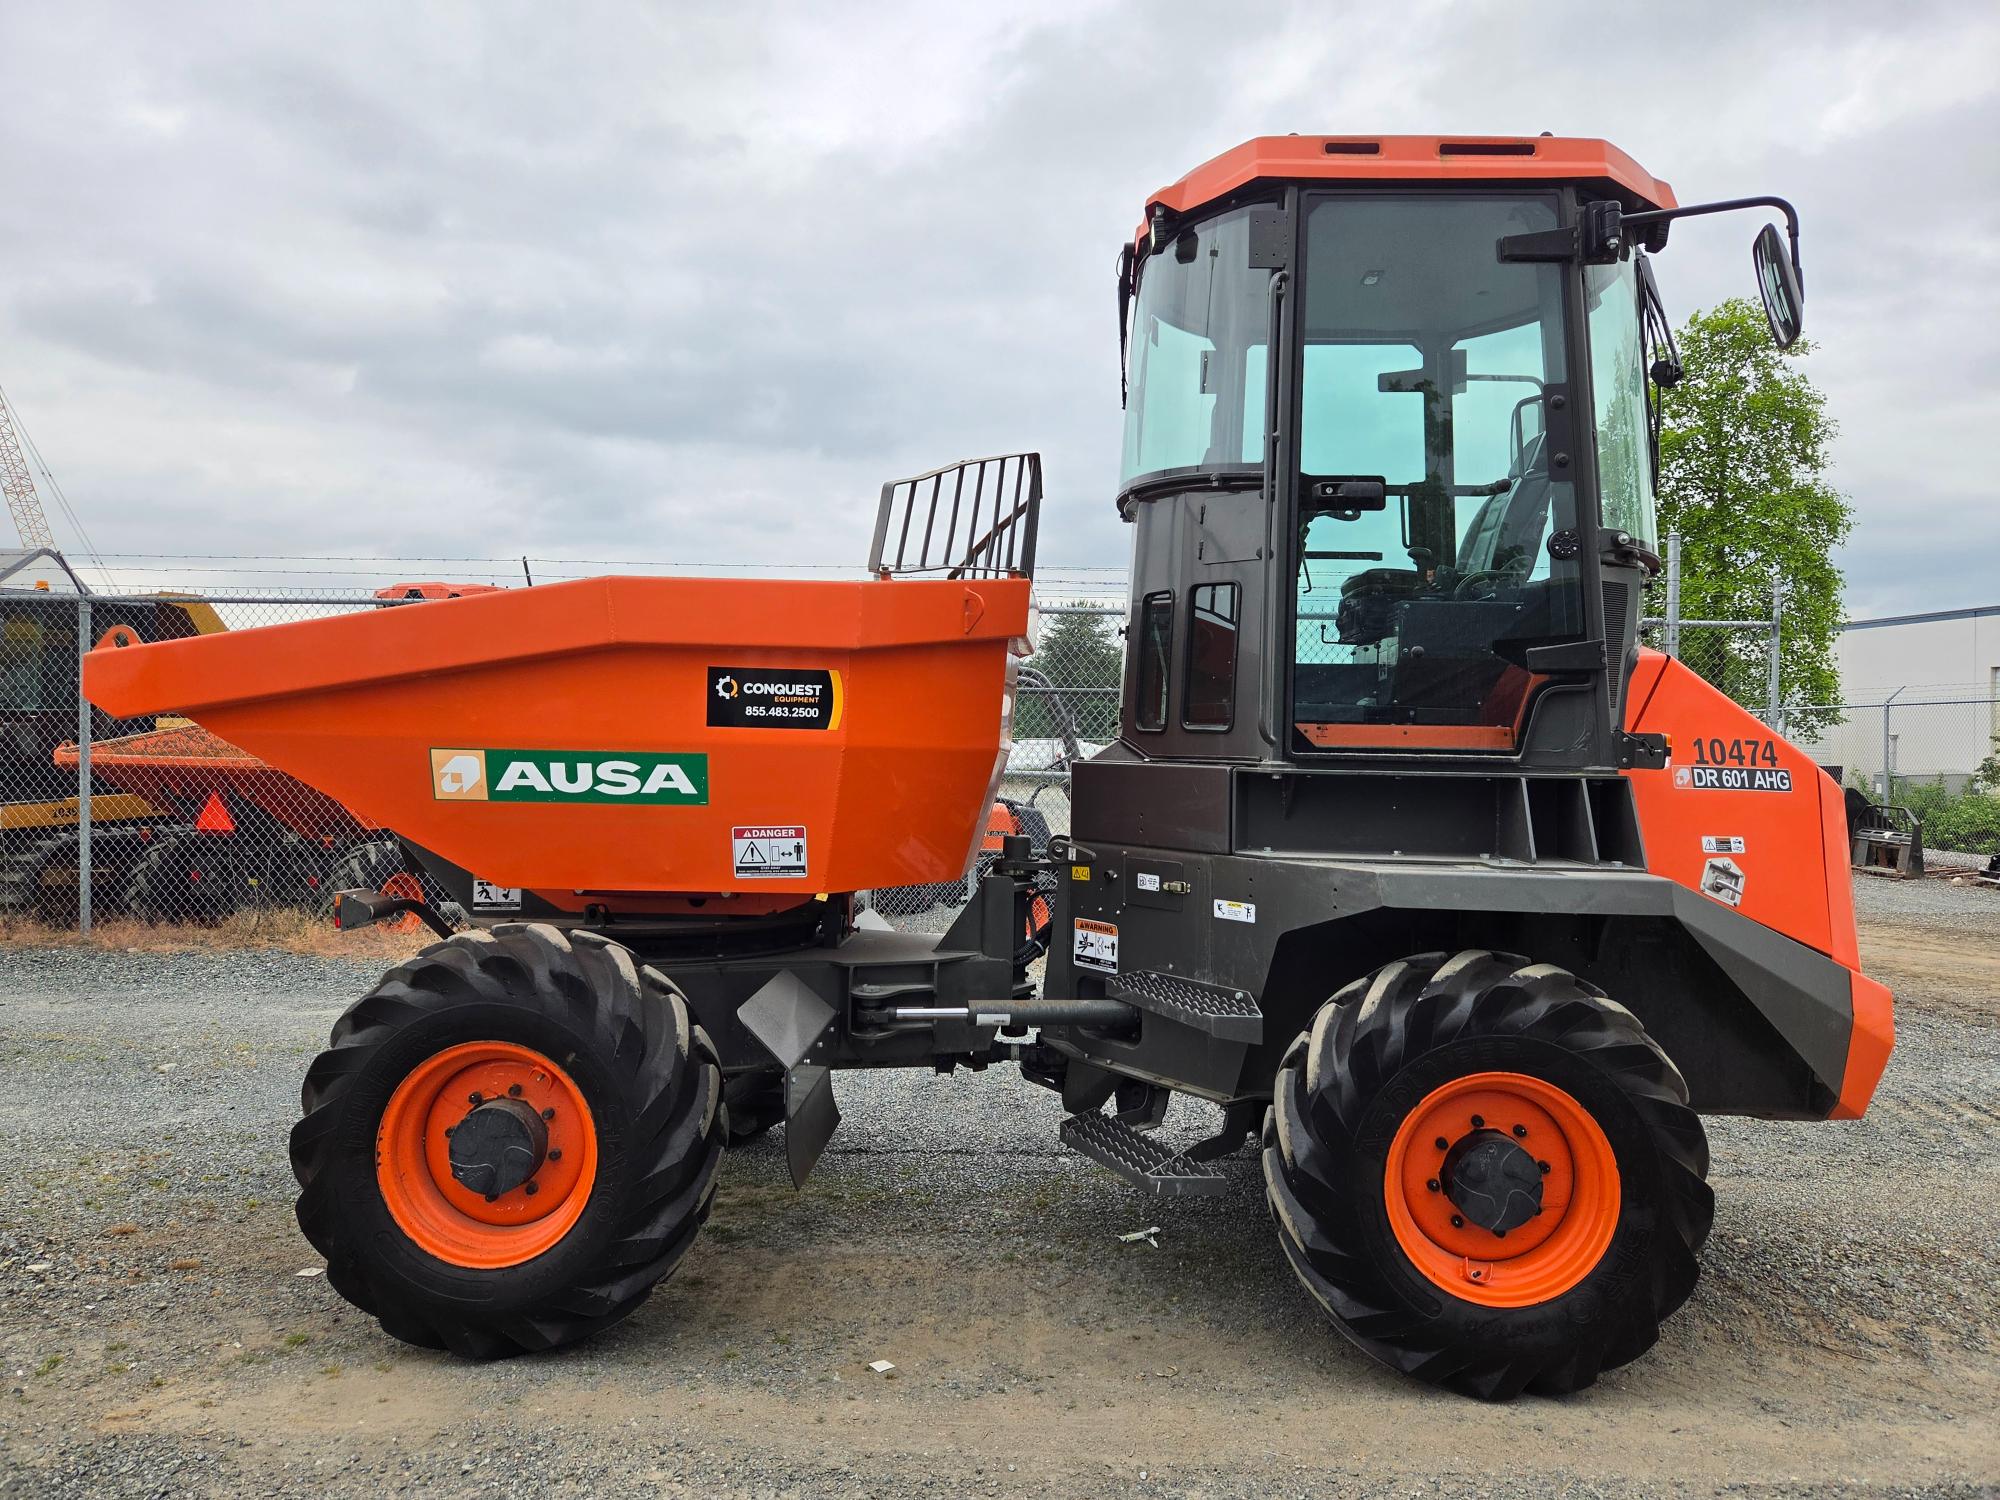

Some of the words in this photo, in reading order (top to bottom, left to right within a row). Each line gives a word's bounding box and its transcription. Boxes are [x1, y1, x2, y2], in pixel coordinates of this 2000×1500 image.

[743, 682, 823, 697] CONQUEST
[774, 696, 820, 704] EQUIPMENT
[745, 706, 820, 719] 855.483.2500
[1693, 738, 1778, 767] 10474
[494, 760, 699, 796] AUSA
[1693, 768, 1720, 787] DR
[1722, 769, 1749, 788] 601
[1754, 770, 1790, 790] AHG
[752, 829, 796, 838] DANGER
[1084, 922, 1114, 934] WARNING
